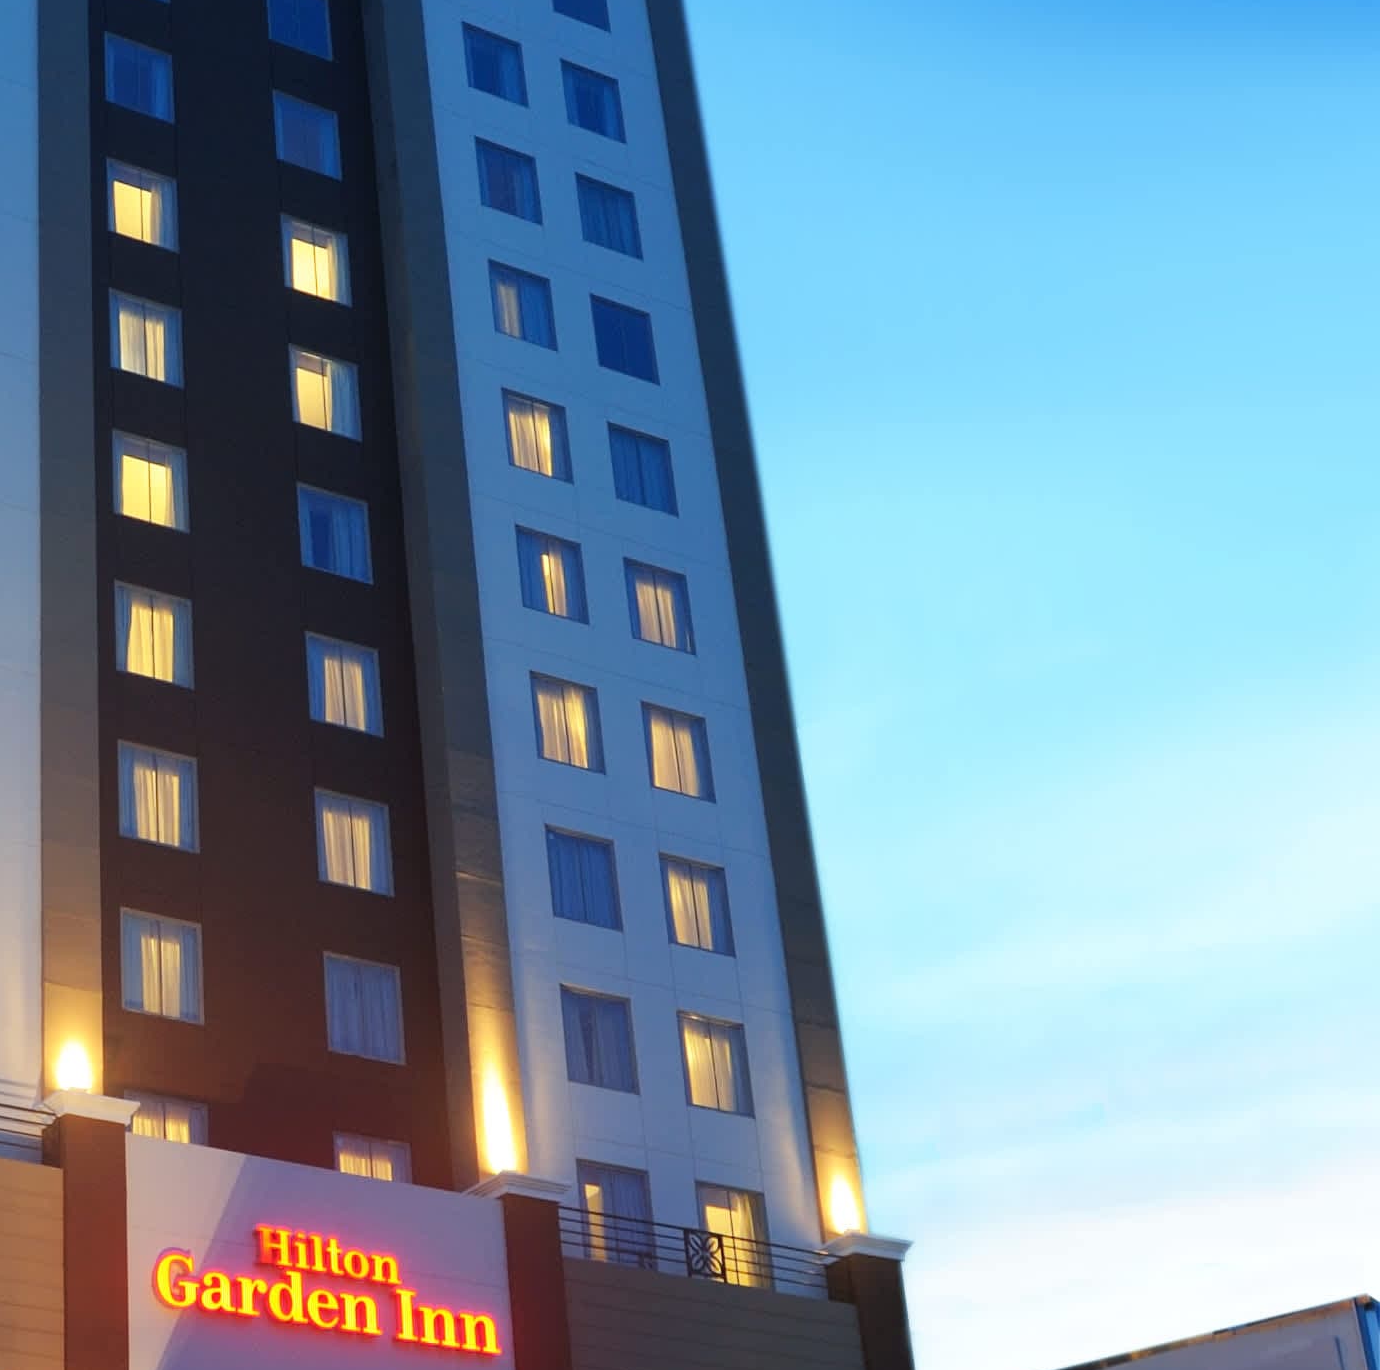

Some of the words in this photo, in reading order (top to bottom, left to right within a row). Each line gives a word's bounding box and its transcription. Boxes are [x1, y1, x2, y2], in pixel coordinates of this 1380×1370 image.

[256, 1224, 401, 1284] Hilton
[155, 1252, 382, 1336] Garden
[394, 1287, 502, 1356] Inn
